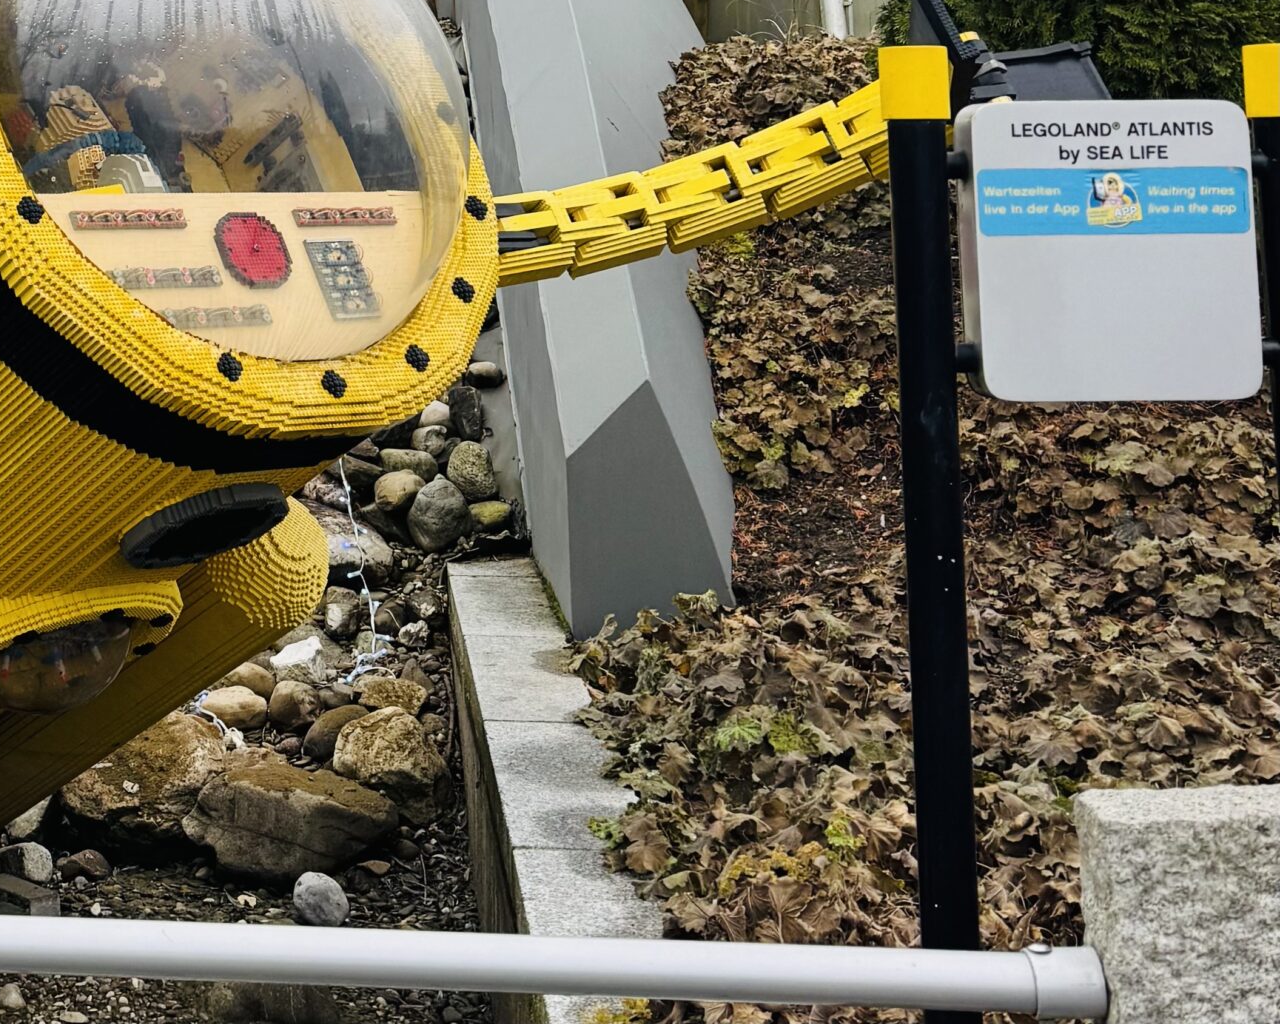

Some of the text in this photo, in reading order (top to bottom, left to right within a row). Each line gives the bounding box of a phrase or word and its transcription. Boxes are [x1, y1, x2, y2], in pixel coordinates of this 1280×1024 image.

[1127, 121, 1214, 137] ATLANTIS
[1058, 145, 1169, 164] by SEA LIFE
[983, 186, 1061, 197] Wartezeiten
[1147, 186, 1235, 199] Waiting times
[984, 203, 1080, 216] live in der App
[1147, 203, 1237, 216] live in the app
